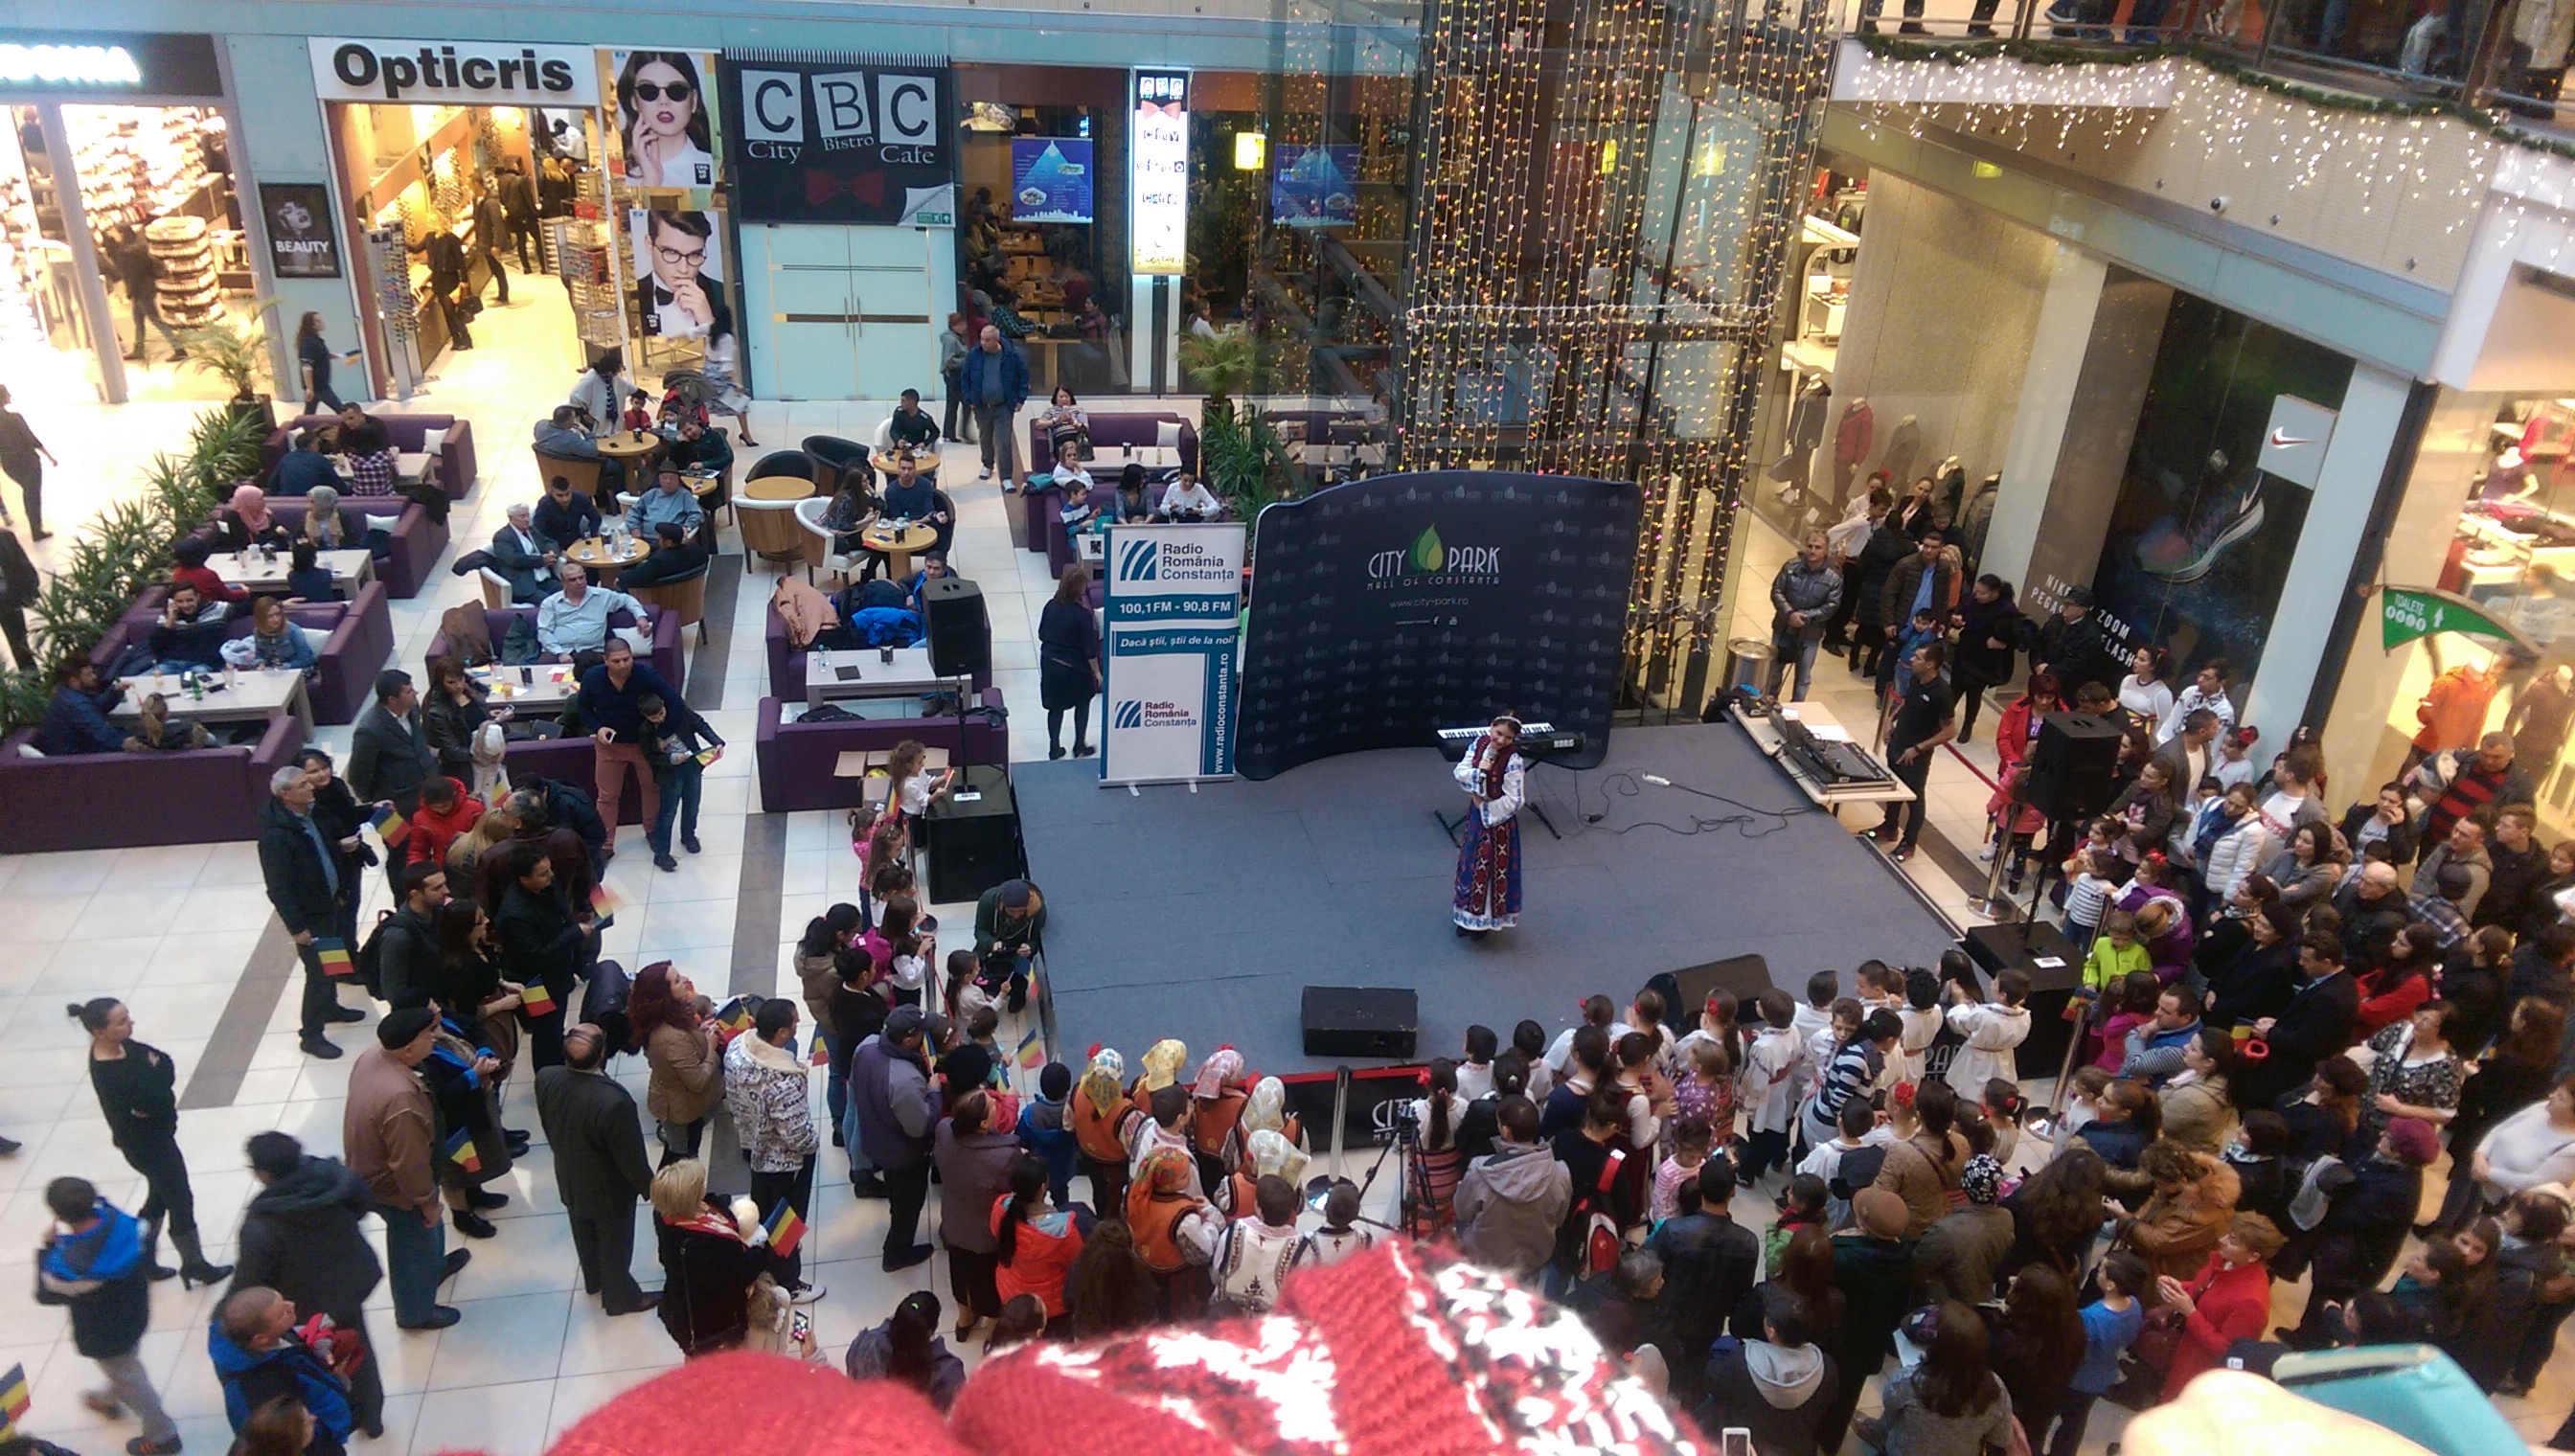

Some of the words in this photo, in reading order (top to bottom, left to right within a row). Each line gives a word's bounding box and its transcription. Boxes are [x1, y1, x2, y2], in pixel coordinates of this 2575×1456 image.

[333, 42, 574, 99] Opticris
[747, 141, 803, 165] City
[823, 135, 875, 151] Bistro
[879, 145, 935, 164] Cafe
[275, 240, 330, 253] BEAUTY
[1162, 543, 1203, 555] Radio
[1162, 555, 1224, 567] România
[1368, 549, 1407, 579] CITY
[1447, 546, 1501, 574] PARK
[1366, 580, 1395, 591] MALL
[1402, 578, 1420, 587] OF
[1119, 603, 1151, 615] 100,1
[1152, 601, 1172, 613] FM
[1183, 601, 1210, 613] 90,8
[1212, 601, 1231, 612] FM
[1389, 597, 1469, 608] www.city-park.ro
[2394, 593, 2426, 616] TOALETE
[2096, 609, 2131, 640] ZOOM
[1120, 637, 1147, 648] Dacă
[1188, 635, 1201, 645] de
[1203, 635, 1213, 645] la
[1216, 634, 1235, 645] noi!
[1145, 700, 1174, 710] Radio
[1145, 709, 1190, 718] România
[1214, 653, 1229, 773] www.radioconstanta.ro
[1553, 739, 1575, 748] KORG
